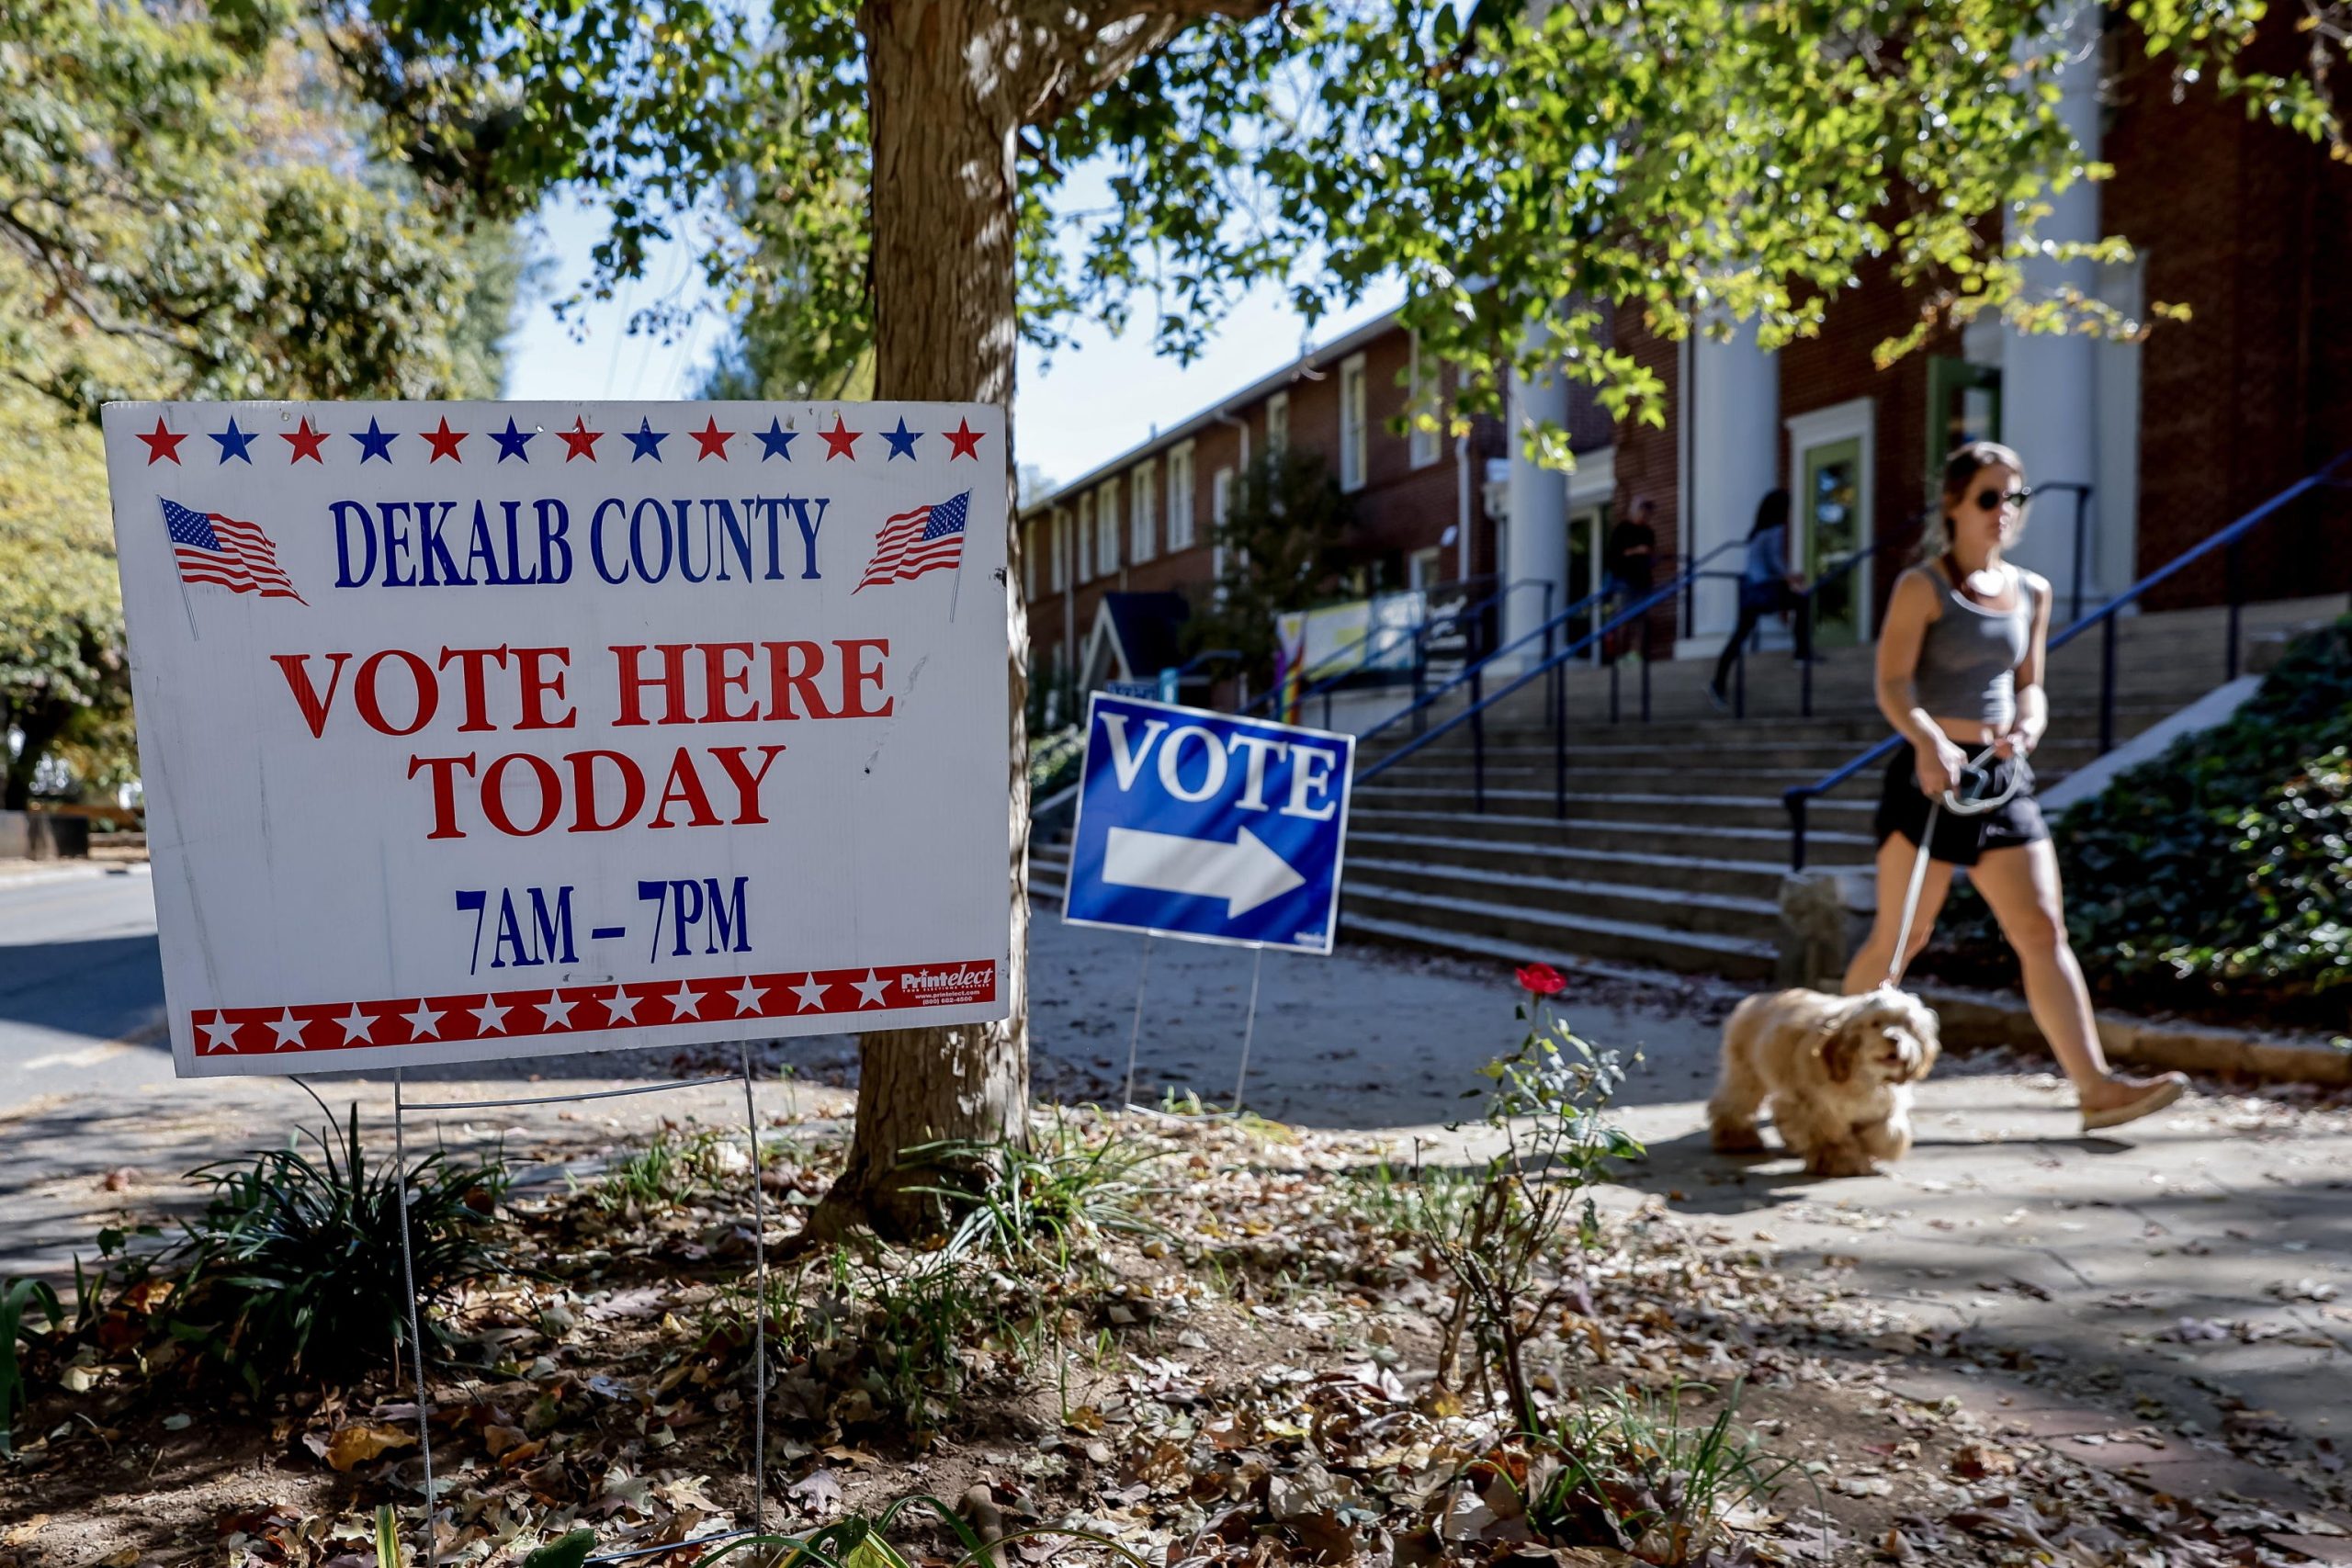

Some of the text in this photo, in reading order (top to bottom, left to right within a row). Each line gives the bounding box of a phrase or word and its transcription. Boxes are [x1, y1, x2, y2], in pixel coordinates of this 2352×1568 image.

[329, 493, 830, 588] DEKALB COUNTY
[270, 638, 894, 739] VOTE HERE
[407, 744, 786, 840] TODAY
[1097, 711, 1336, 821] VOTE
[456, 886, 580, 976] 7AM
[638, 876, 752, 964] 7PM
[901, 964, 993, 989] Printelect
[915, 990, 980, 999] www.printelect.com
[922, 998, 940, 1006] (800)
